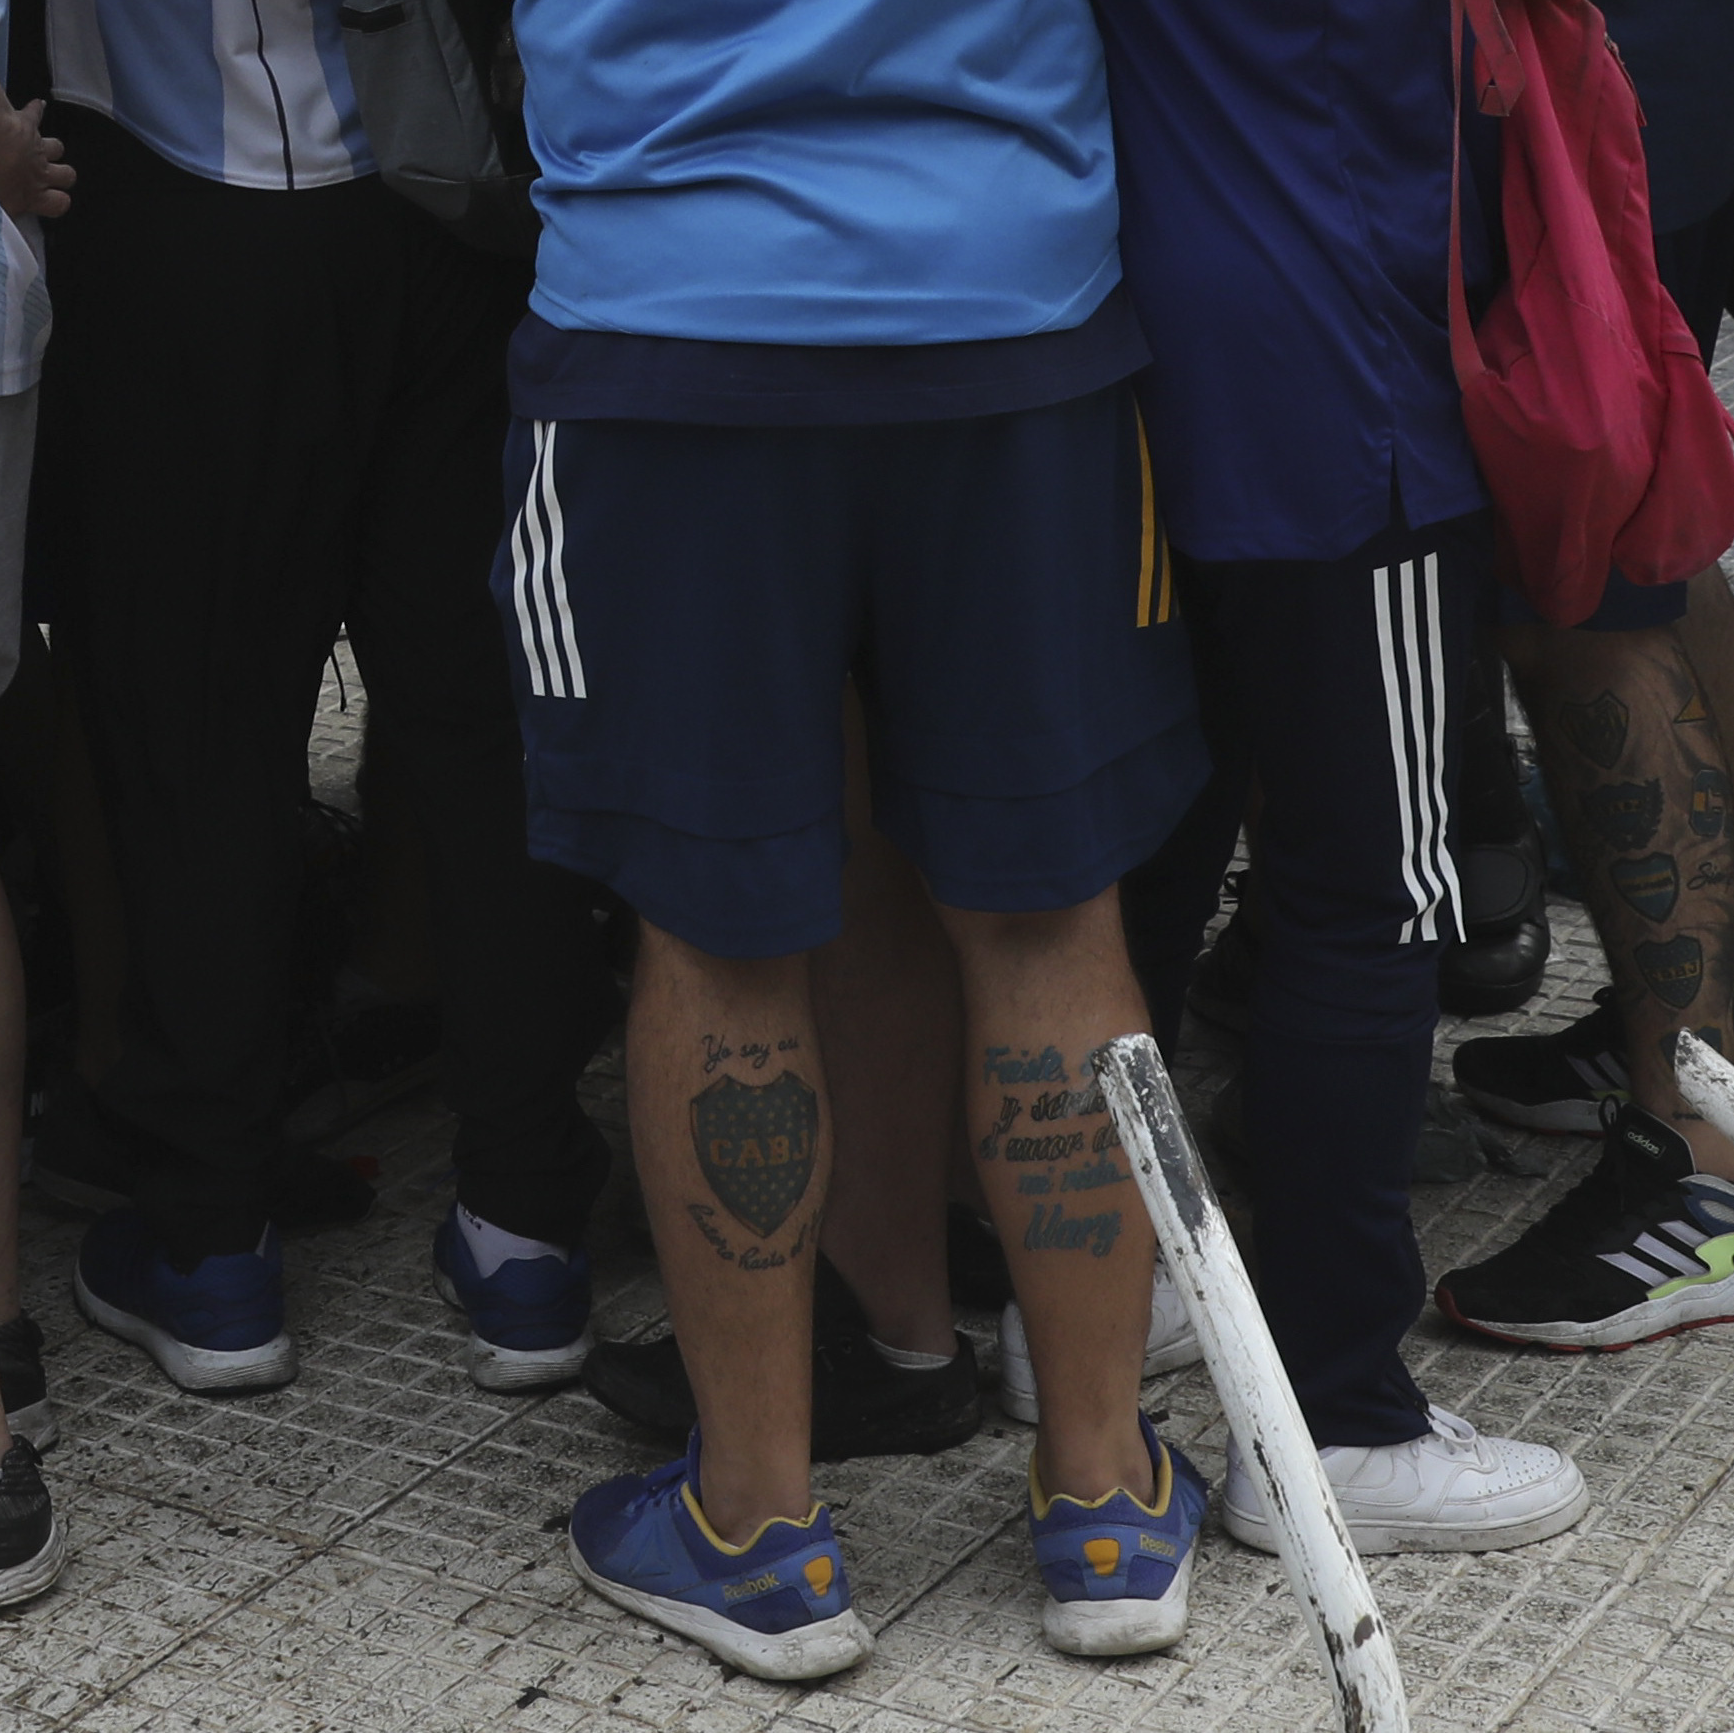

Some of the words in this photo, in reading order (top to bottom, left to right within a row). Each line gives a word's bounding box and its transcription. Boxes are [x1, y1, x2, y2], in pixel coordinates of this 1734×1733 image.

[710, 1129, 810, 1167] CABJ
[1627, 1130, 1661, 1156] adidas
[722, 1572, 780, 1603] Reebok
